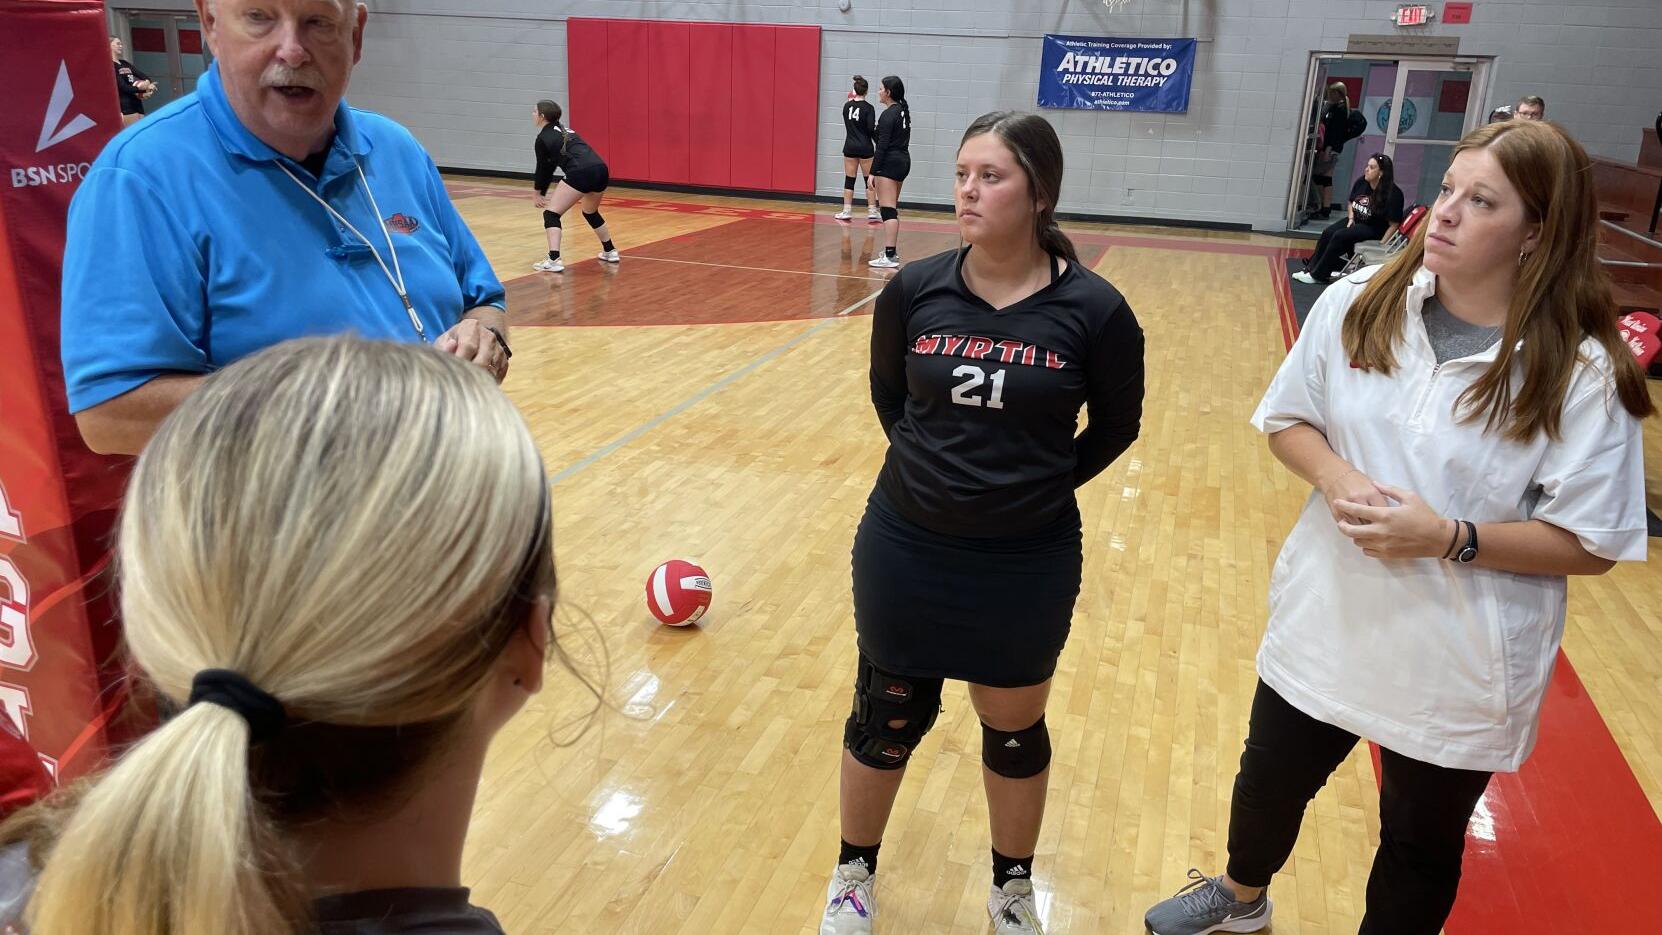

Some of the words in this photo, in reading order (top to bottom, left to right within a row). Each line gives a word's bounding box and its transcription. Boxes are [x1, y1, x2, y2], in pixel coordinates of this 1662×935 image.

[1400, 8, 1425, 23] EXIT
[1057, 52, 1177, 75] ATHLETICO
[1063, 73, 1114, 86] PHYSICAL
[1117, 75, 1167, 87] THERAPY
[848, 106, 860, 121] 14
[11, 165, 57, 188] BSN
[951, 364, 1006, 409] 21
